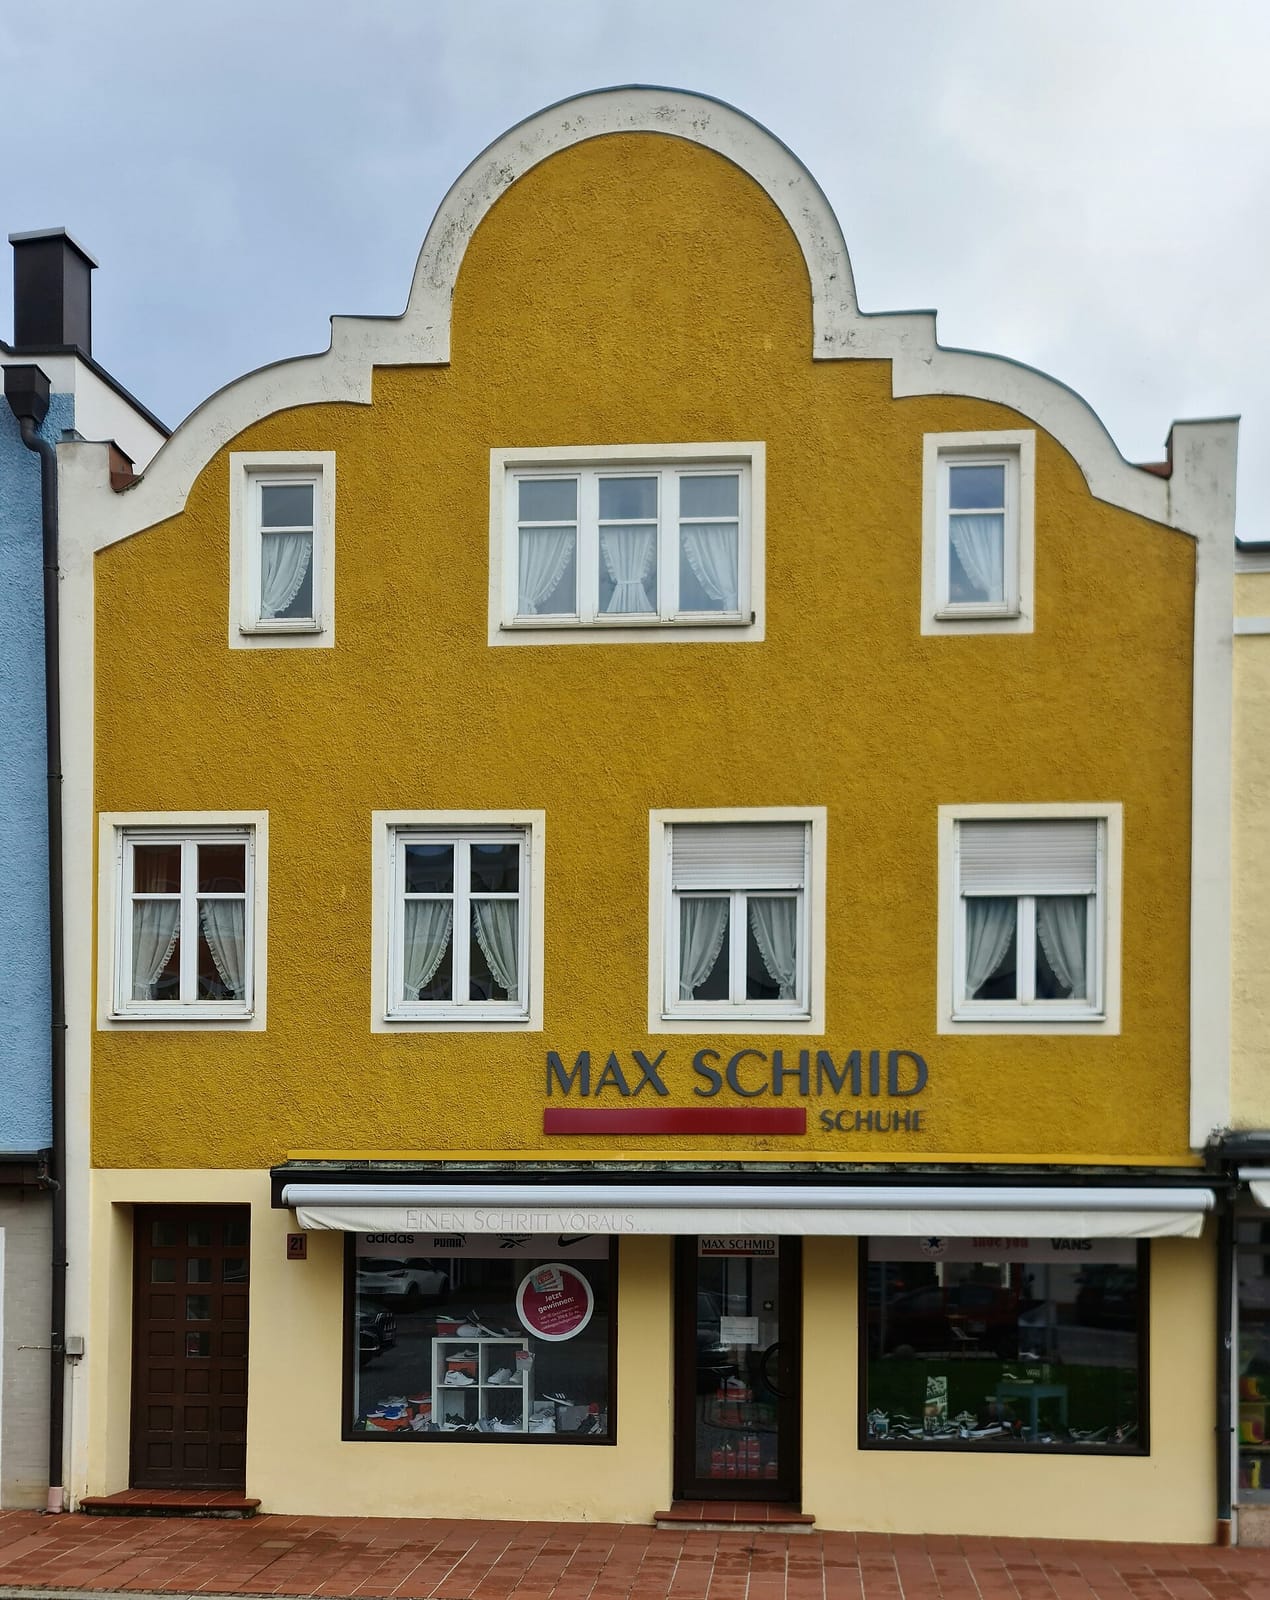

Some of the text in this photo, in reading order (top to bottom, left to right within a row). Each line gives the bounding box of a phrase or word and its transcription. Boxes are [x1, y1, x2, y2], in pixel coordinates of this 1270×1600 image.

[547, 1049, 928, 1097] MAX SCHMID
[819, 1109, 926, 1132] SCHUHE
[406, 1209, 465, 1230] EINEN
[474, 1209, 552, 1231] SCHRITT
[290, 1236, 303, 1251] 21
[366, 1233, 415, 1244] adidas
[433, 1237, 462, 1248] PUMA
[701, 1239, 775, 1249] MAX SCHMID
[1050, 1237, 1093, 1250] VANS
